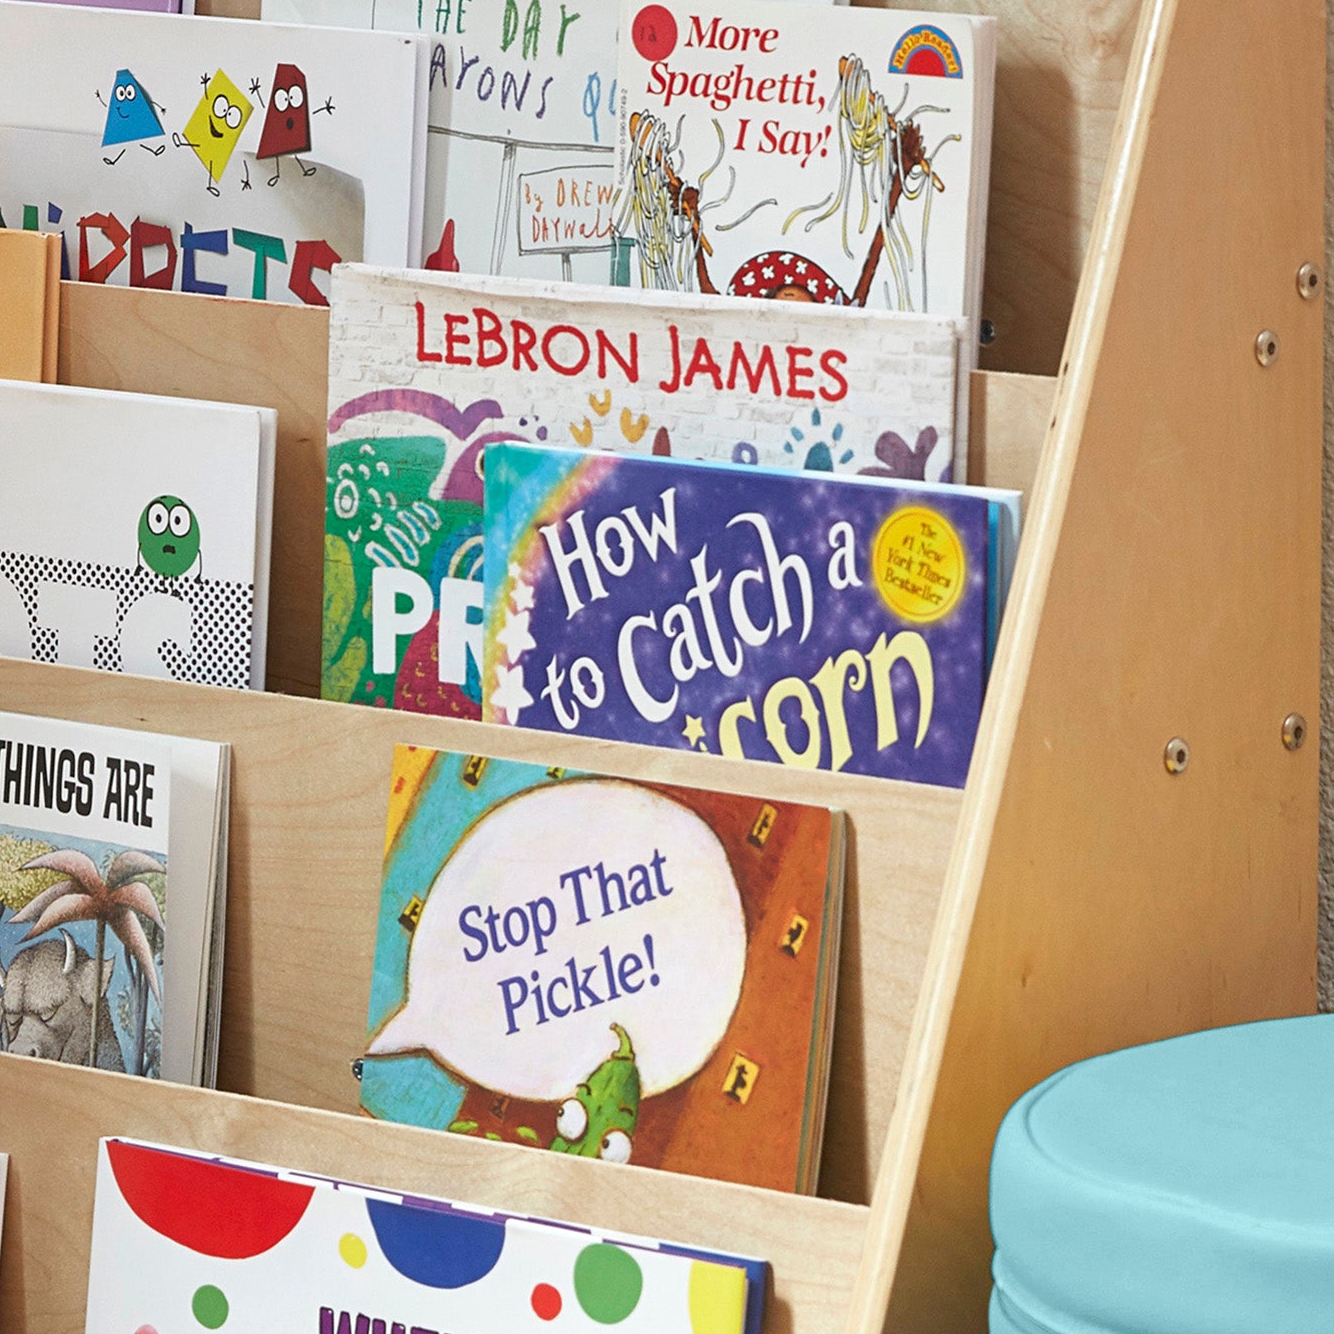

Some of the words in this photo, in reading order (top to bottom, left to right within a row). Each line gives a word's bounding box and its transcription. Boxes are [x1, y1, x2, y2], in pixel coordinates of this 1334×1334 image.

[684, 15, 779, 53] More
[646, 61, 826, 114] Spaghetti,
[556, 177, 614, 208] DREW
[733, 118, 751, 151] I
[758, 120, 832, 168] Say!
[413, 301, 640, 383] LEBRON
[658, 324, 850, 404] JAMES
[538, 487, 679, 620] How
[540, 651, 606, 732] to
[616, 512, 815, 724] Catch
[827, 521, 864, 591] a
[682, 631, 934, 772] corn
[103, 756, 156, 828] ARE
[458, 895, 558, 964] Stop
[559, 848, 675, 927] That
[497, 933, 662, 1036] Pickle!
